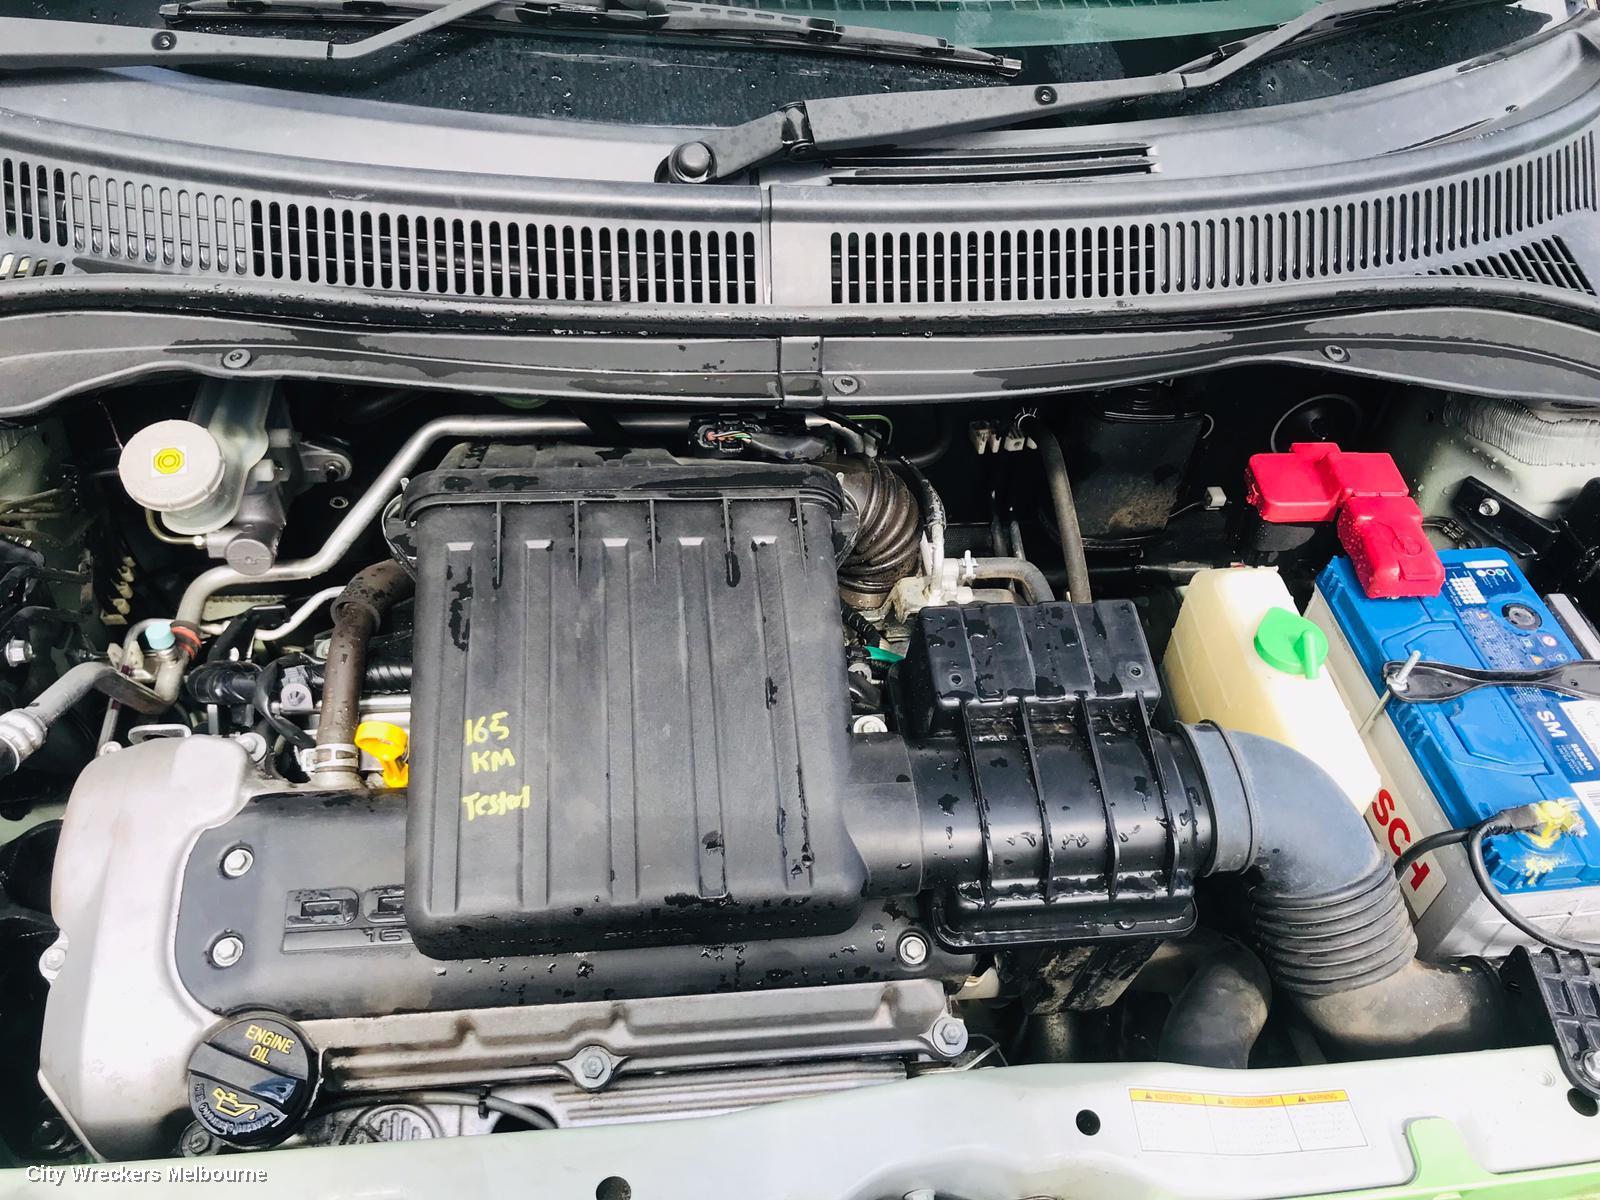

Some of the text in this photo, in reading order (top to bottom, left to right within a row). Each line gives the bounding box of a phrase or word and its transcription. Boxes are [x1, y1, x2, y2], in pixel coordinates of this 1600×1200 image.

[464, 711, 510, 746] 165
[1536, 709, 1568, 739] SM
[471, 748, 516, 774] KM
[1372, 789, 1431, 891] SCH
[246, 1024, 295, 1054] ENGINE
[249, 1044, 270, 1065] OIL
